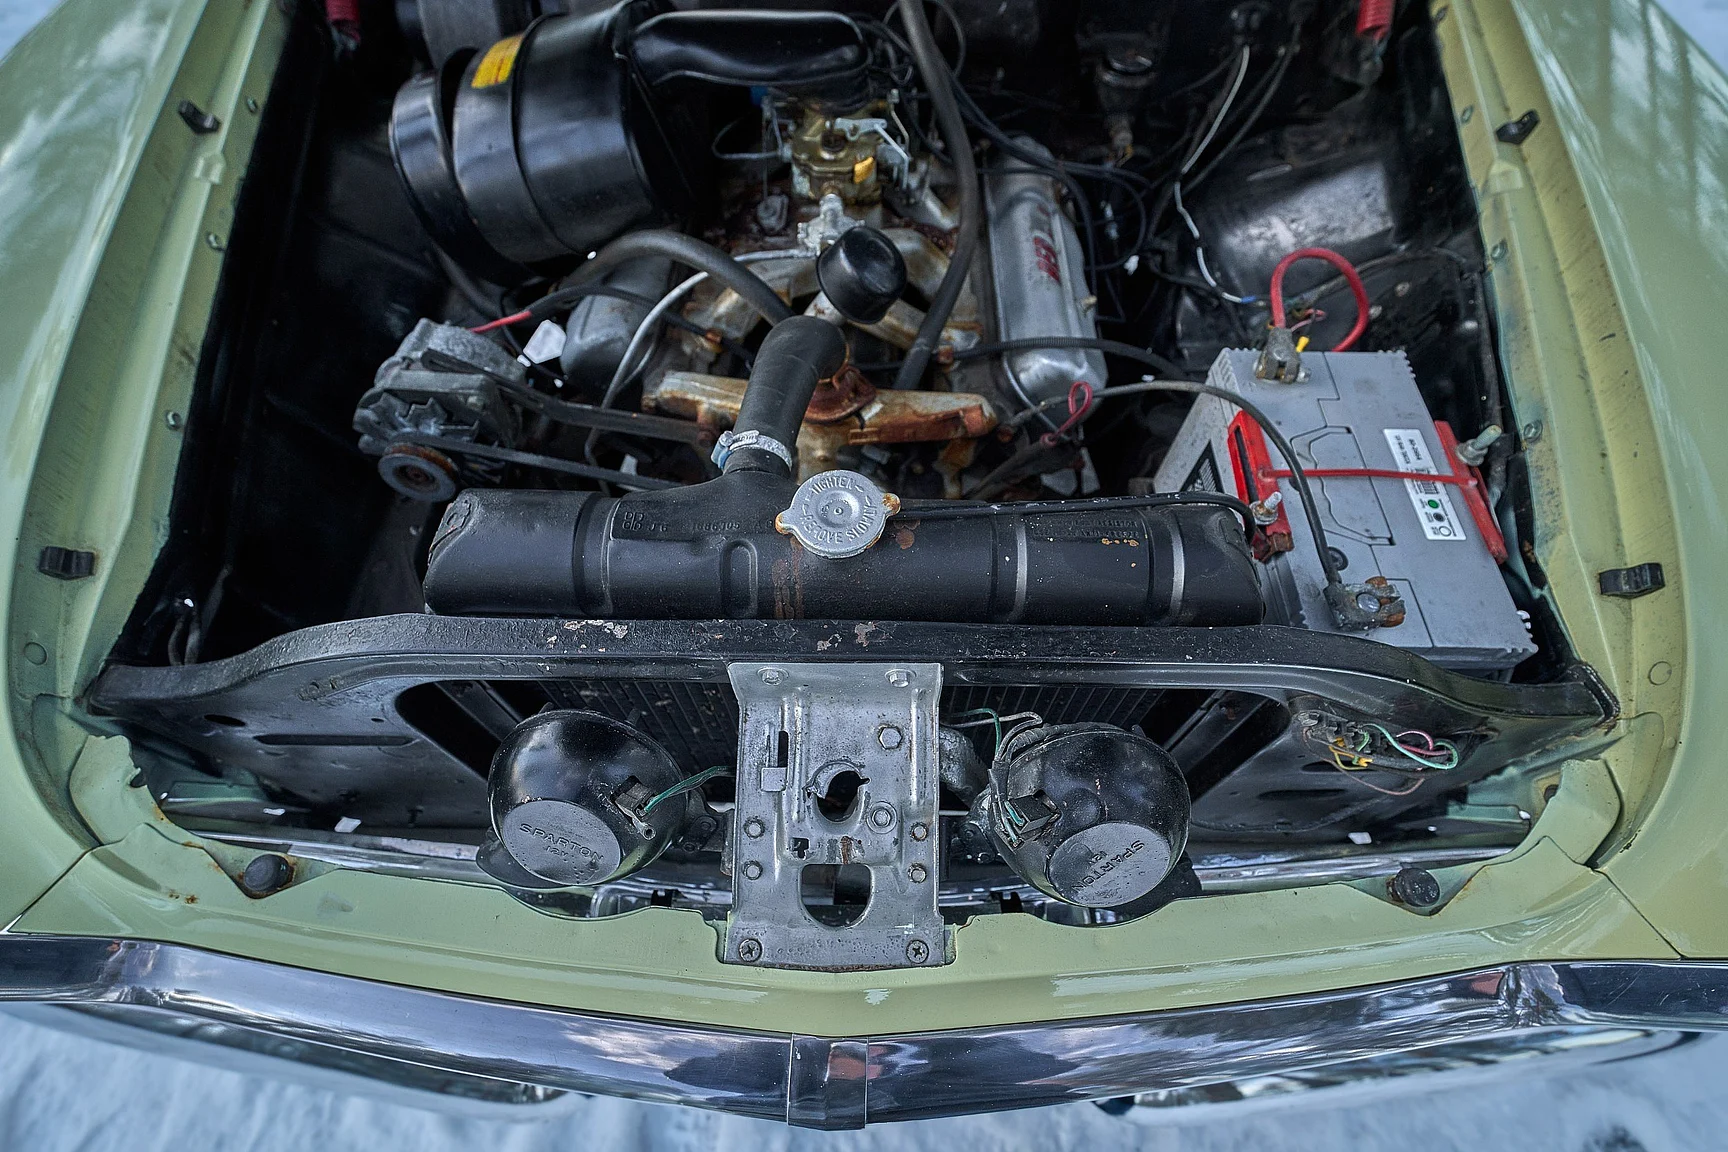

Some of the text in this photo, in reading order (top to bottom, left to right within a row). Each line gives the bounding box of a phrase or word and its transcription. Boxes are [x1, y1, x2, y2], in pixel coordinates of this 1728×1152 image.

[811, 475, 855, 495] TIGHTEN
[800, 515, 844, 544] REMOVE
[845, 503, 878, 542] SLOWLY
[519, 823, 604, 862] SPARTON
[1072, 839, 1146, 893] SPARTON
